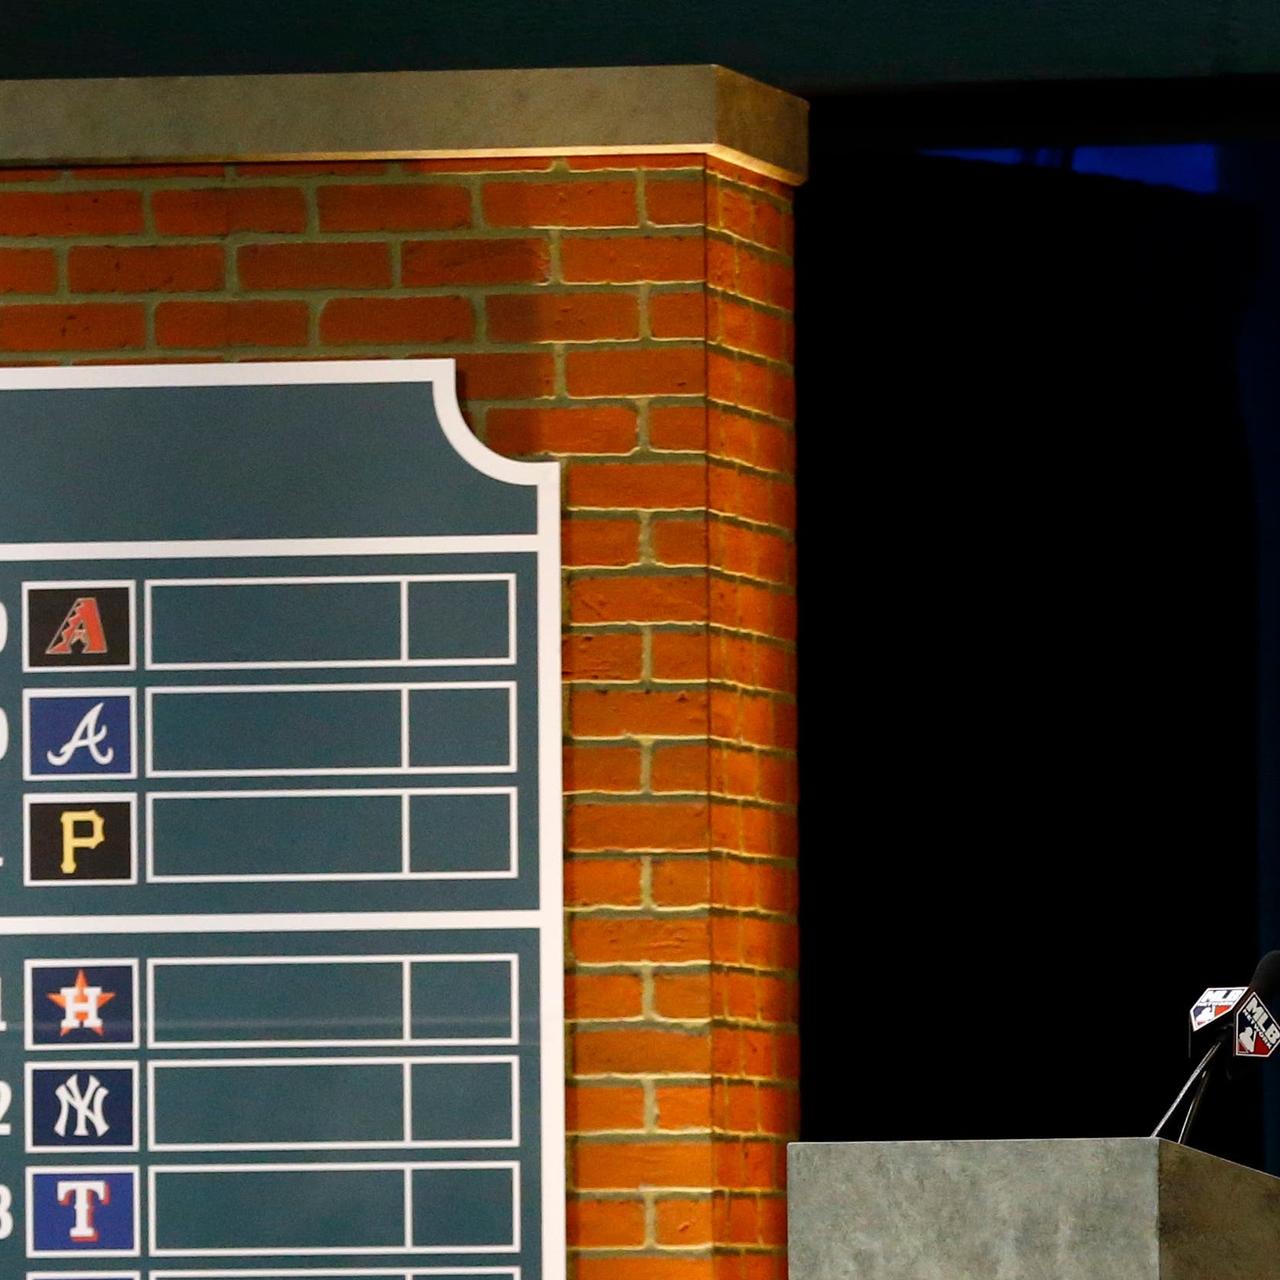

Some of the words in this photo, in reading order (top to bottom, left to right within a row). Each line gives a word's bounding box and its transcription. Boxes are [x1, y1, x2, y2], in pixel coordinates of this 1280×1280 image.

[45, 597, 107, 654] A
[47, 703, 113, 765] A
[60, 810, 105, 873] P
[59, 986, 103, 1028] H
[1246, 997, 1280, 1044] MLB
[57, 1180, 110, 1242] T
